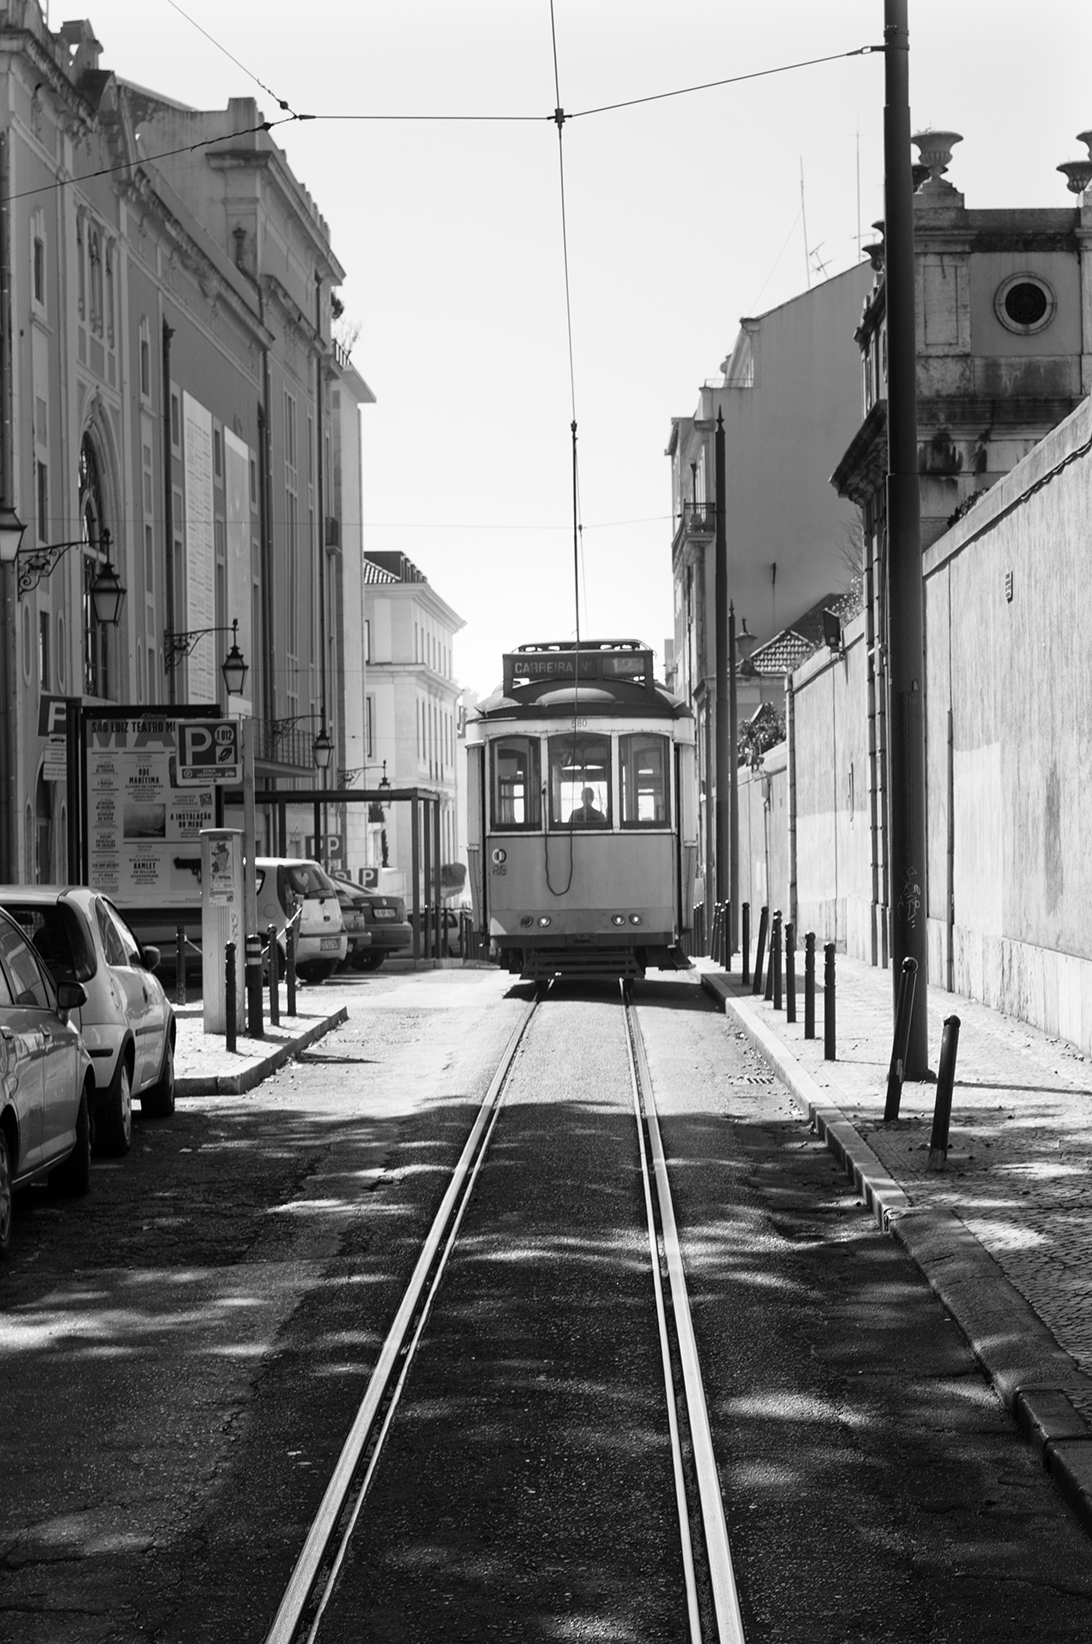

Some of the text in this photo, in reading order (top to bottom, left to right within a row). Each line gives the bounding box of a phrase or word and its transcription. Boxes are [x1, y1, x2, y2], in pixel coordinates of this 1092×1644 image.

[514, 662, 574, 674] CARREIRA
[48, 701, 67, 733] P
[92, 719, 111, 733] SÃO
[111, 721, 129, 733] LUIZ
[132, 721, 164, 733] TEATRO
[571, 718, 588, 729] 580
[185, 727, 213, 766] P
[138, 768, 150, 777] ODE
[129, 776, 160, 785] MARÍTIMA
[170, 813, 175, 821] A
[175, 811, 212, 822] INSTALAÇÃO
[327, 836, 340, 859] P
[133, 862, 156, 870] HAMLET
[362, 869, 375, 887] P
